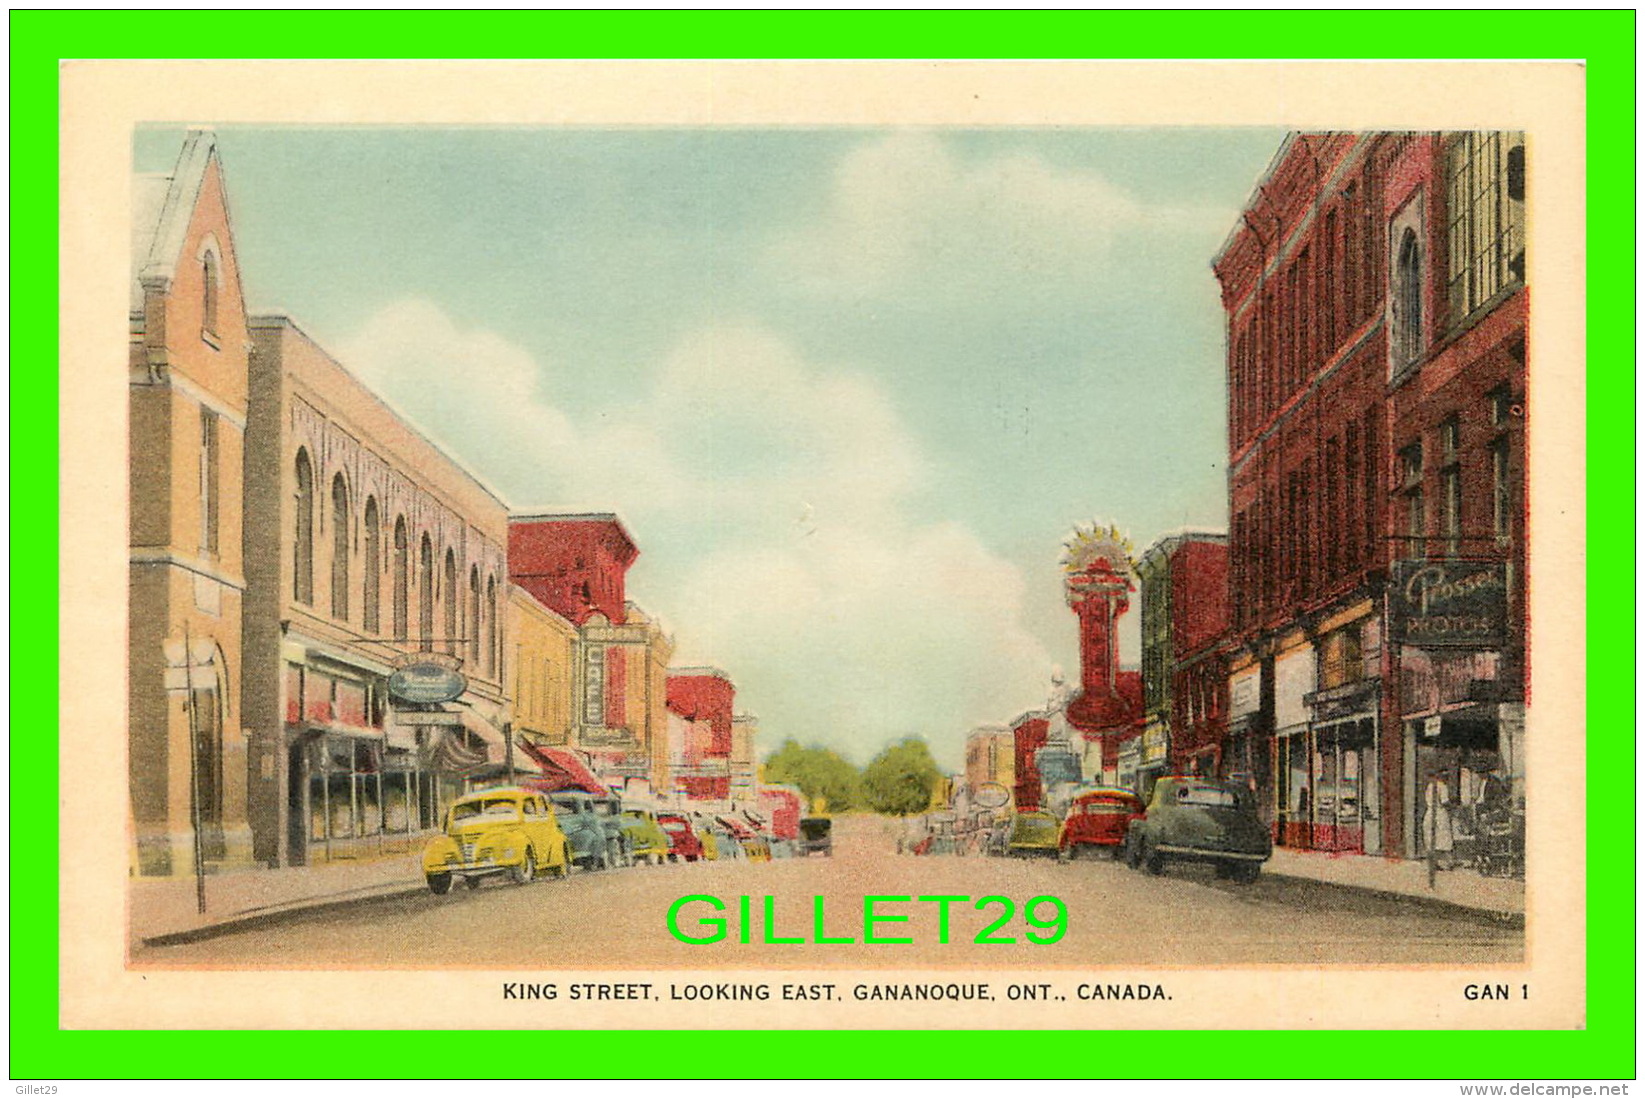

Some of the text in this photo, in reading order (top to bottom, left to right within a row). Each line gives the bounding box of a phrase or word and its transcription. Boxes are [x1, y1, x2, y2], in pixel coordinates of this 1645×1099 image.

[503, 983, 1173, 1002] KING STREET, LOOKING EAST, GANANOQUE, ONT., CANADA.
[1464, 983, 1528, 1000] GAN 1
